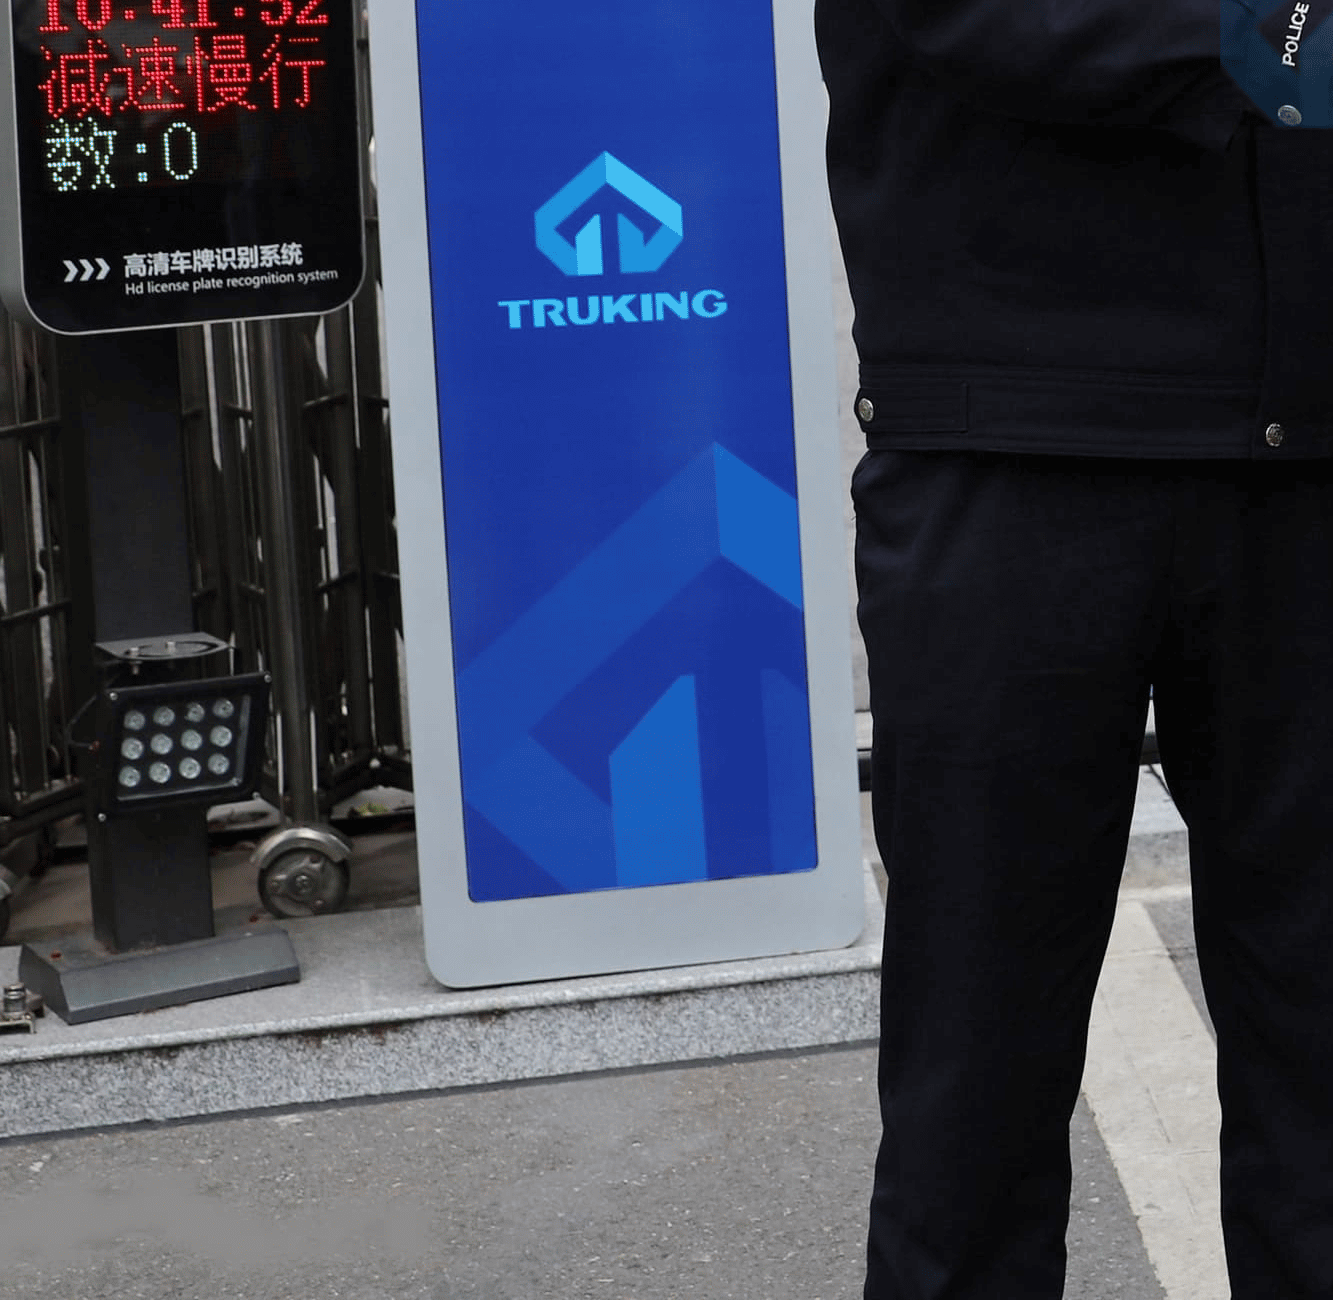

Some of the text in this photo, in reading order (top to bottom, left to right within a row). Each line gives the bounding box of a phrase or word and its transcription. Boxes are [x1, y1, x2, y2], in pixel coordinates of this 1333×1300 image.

[1281, 1, 1310, 67] POLICE
[37, 34, 326, 117] 减速慢行
[123, 242, 304, 278] 高清车牌识别系统
[125, 269, 339, 295] Hd license plate recognition system
[498, 289, 728, 328] TRUKING
